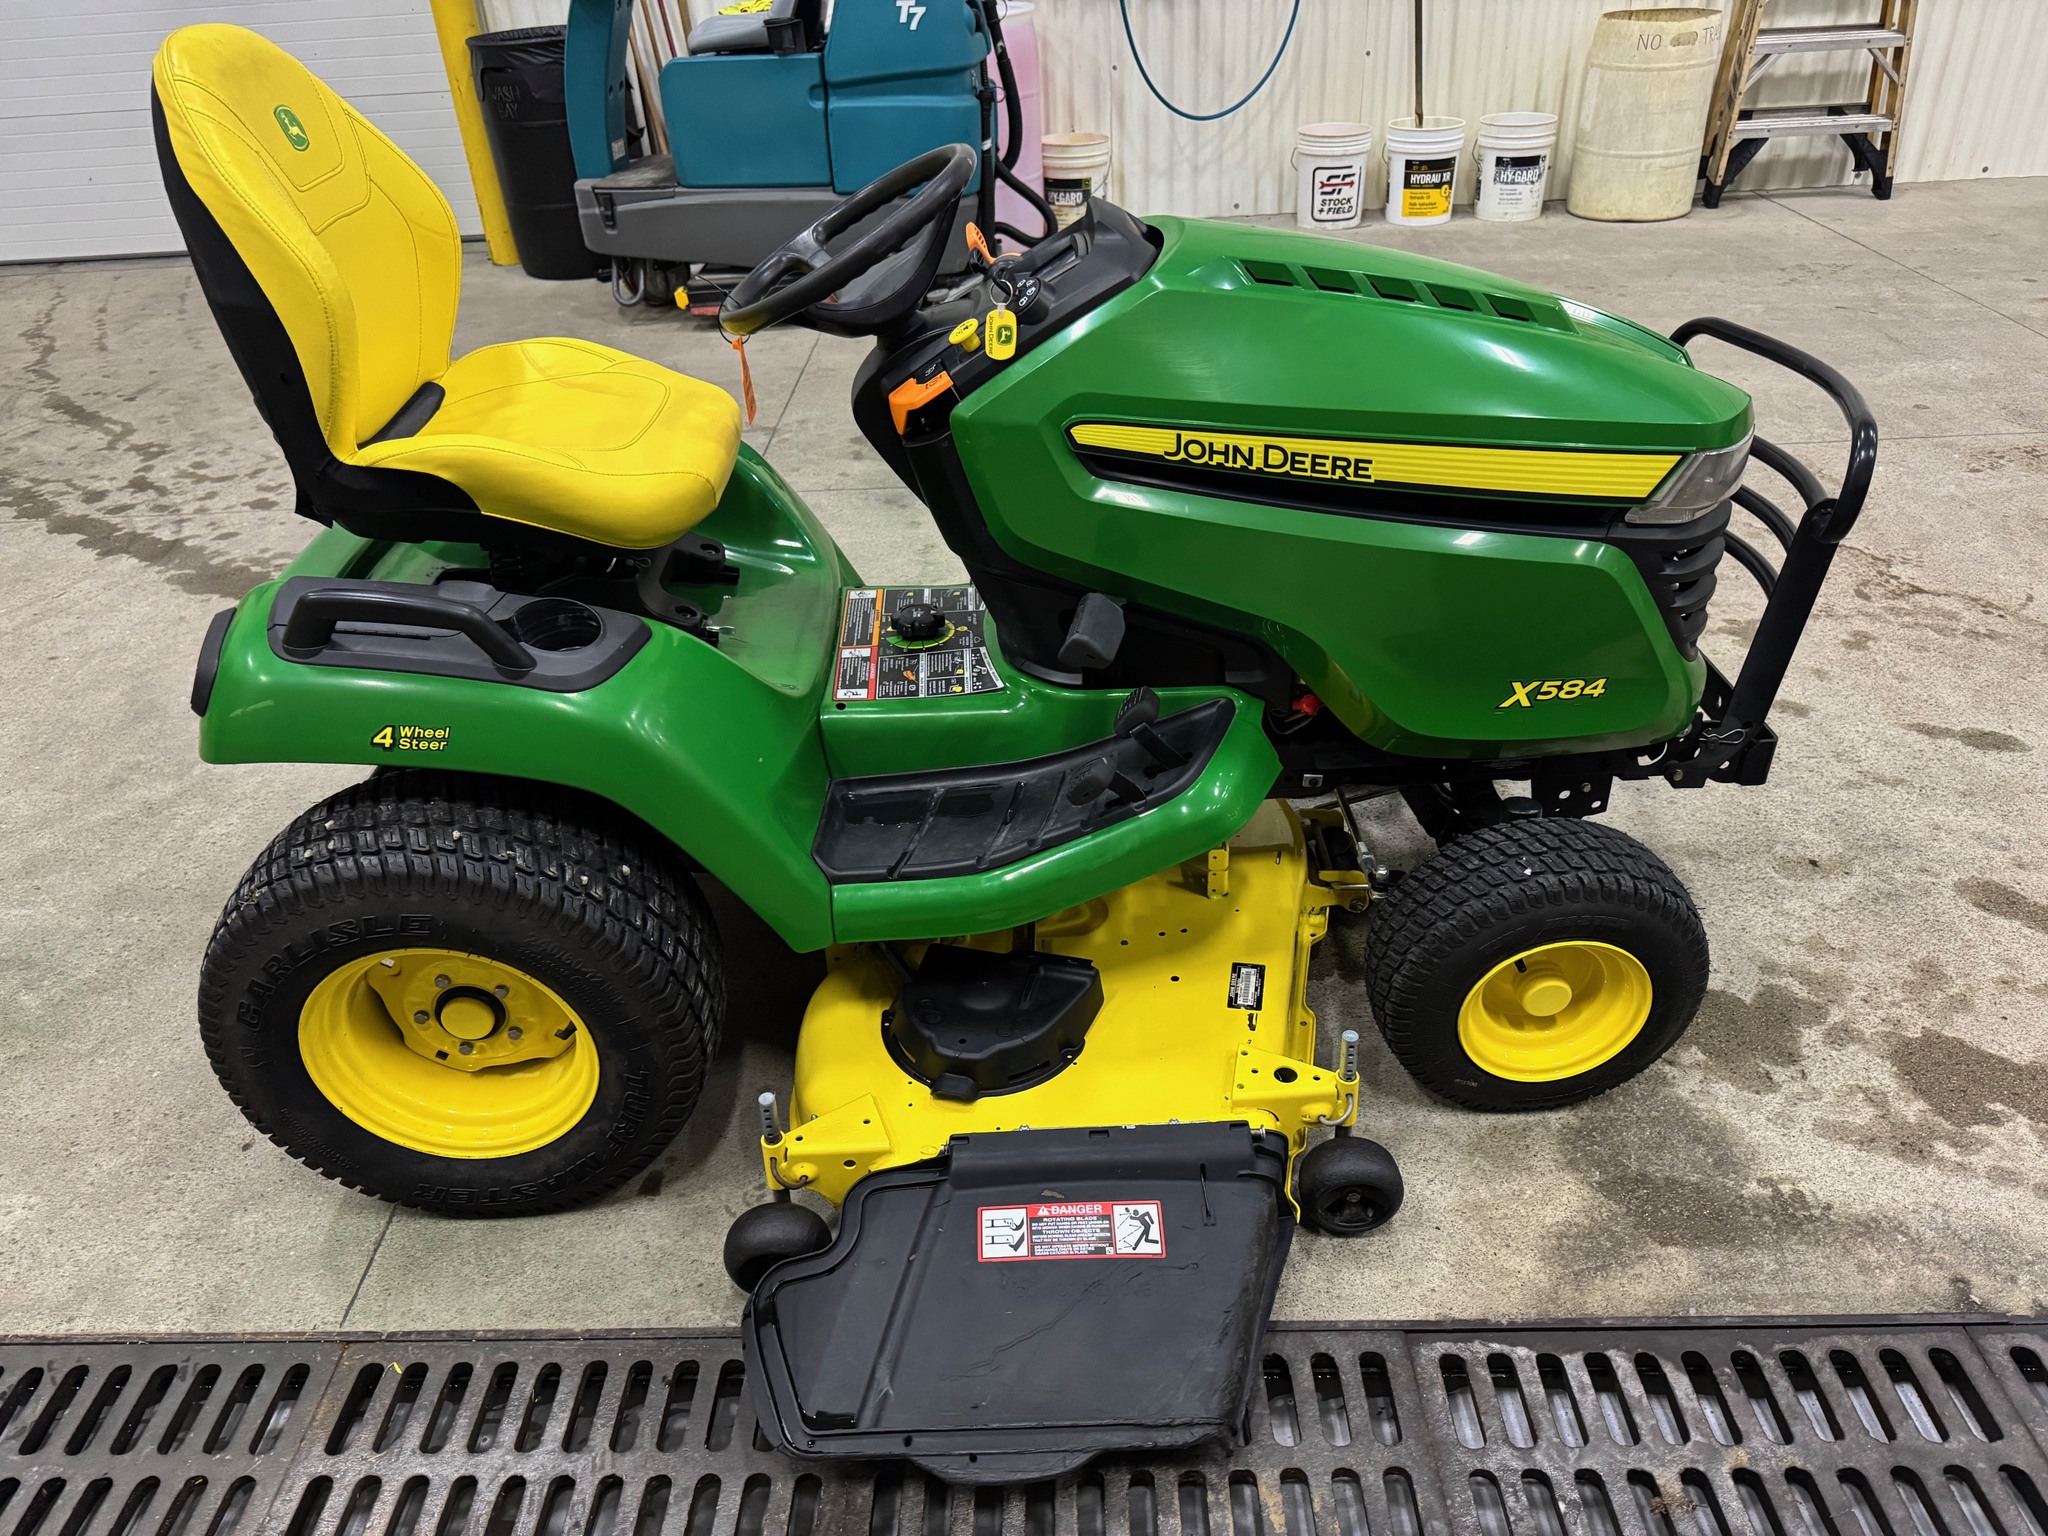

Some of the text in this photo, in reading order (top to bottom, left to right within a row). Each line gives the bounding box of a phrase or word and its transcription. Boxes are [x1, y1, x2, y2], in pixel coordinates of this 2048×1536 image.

[896, 0, 927, 30] T7
[1637, 33, 1662, 51] NO
[1410, 173, 1441, 184] HYDRAU
[1500, 169, 1539, 183] HY-GARD
[1320, 197, 1353, 207] STOCK
[1326, 205, 1353, 215] FIELD
[1163, 432, 1375, 482] JOHN DEERE
[1497, 678, 1608, 708] X584
[372, 725, 450, 748] 4 Wheel
[398, 738, 448, 750] Steer
[237, 913, 432, 1032] CARLISLE
[413, 1152, 607, 1206] MASTER
[1051, 1204, 1103, 1215] DANGER
